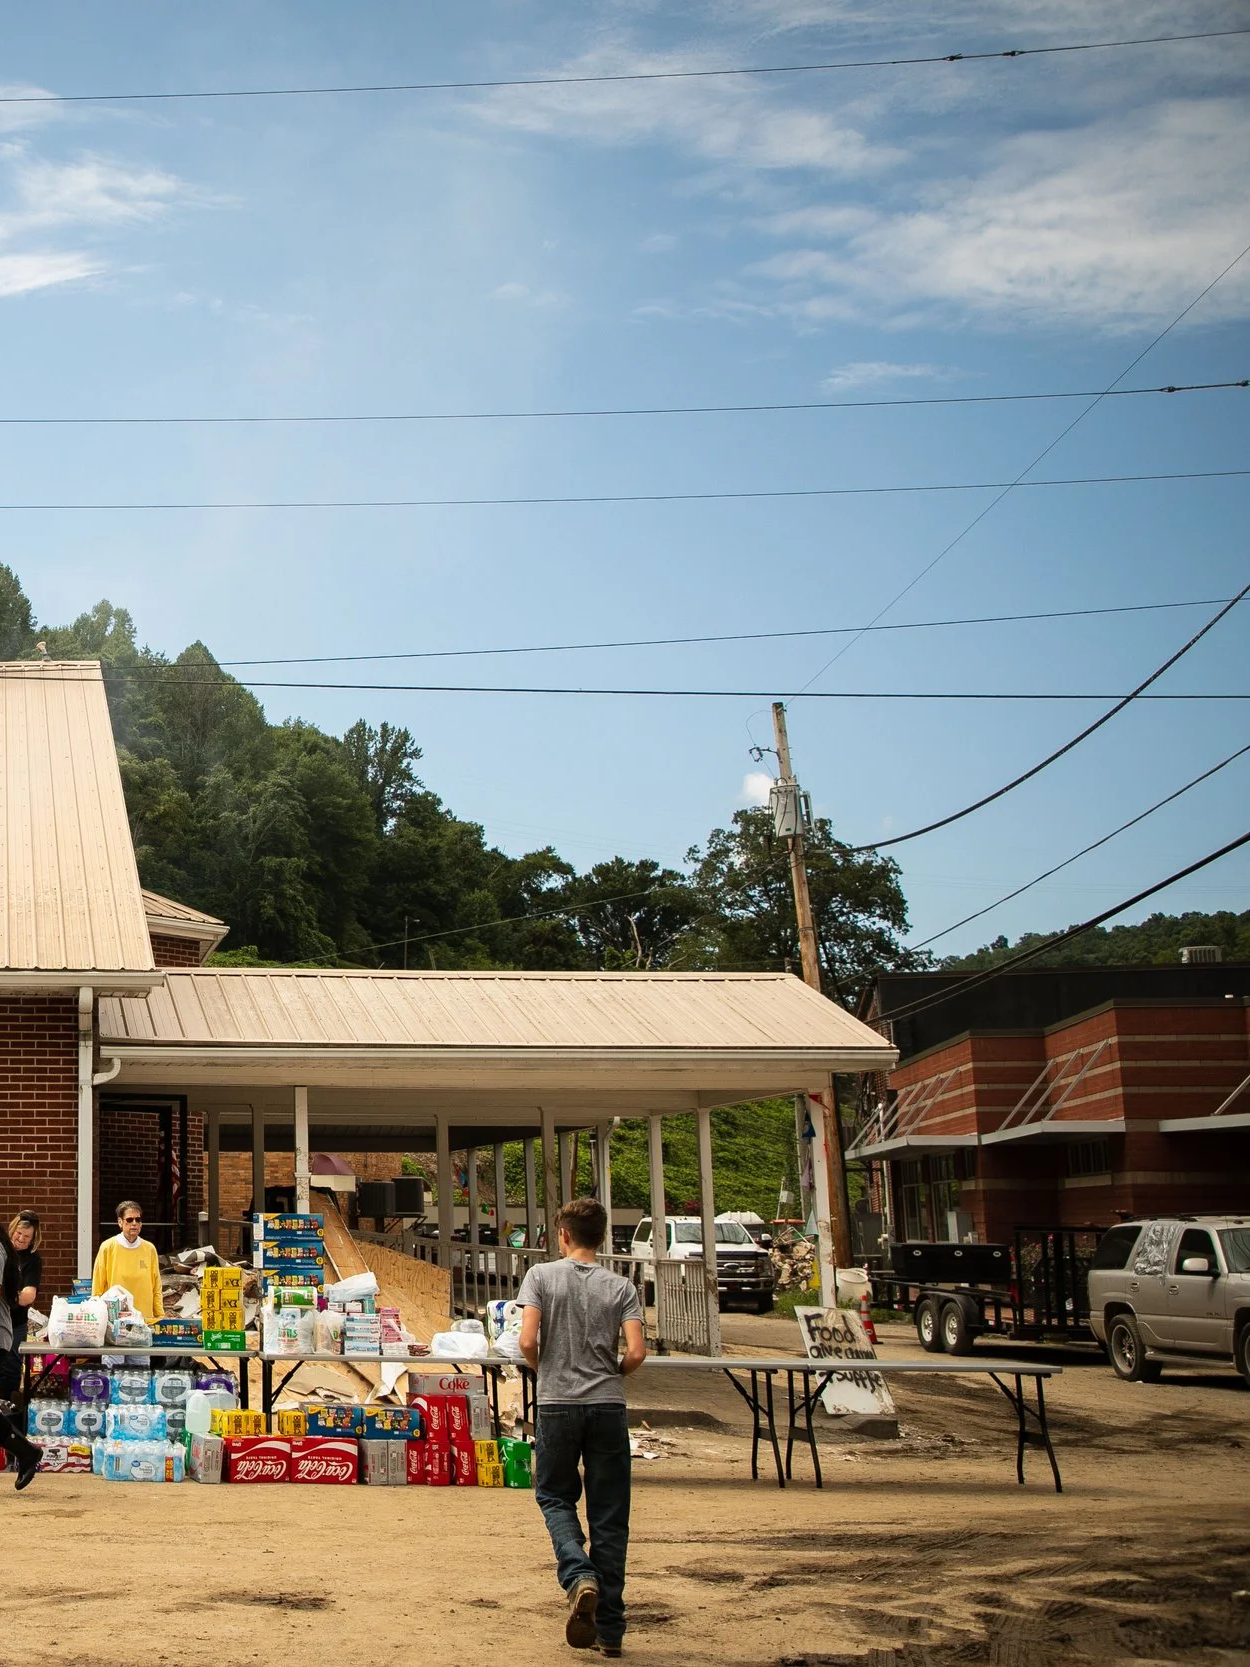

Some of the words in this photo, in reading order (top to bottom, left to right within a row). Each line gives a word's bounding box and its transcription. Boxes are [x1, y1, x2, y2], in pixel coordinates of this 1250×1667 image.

[804, 1313, 856, 1343] Food
[439, 1377, 470, 1390] Coke
[234, 1460, 287, 1480] Coca-Cola
[295, 1460, 353, 1481] Coca-Cola
